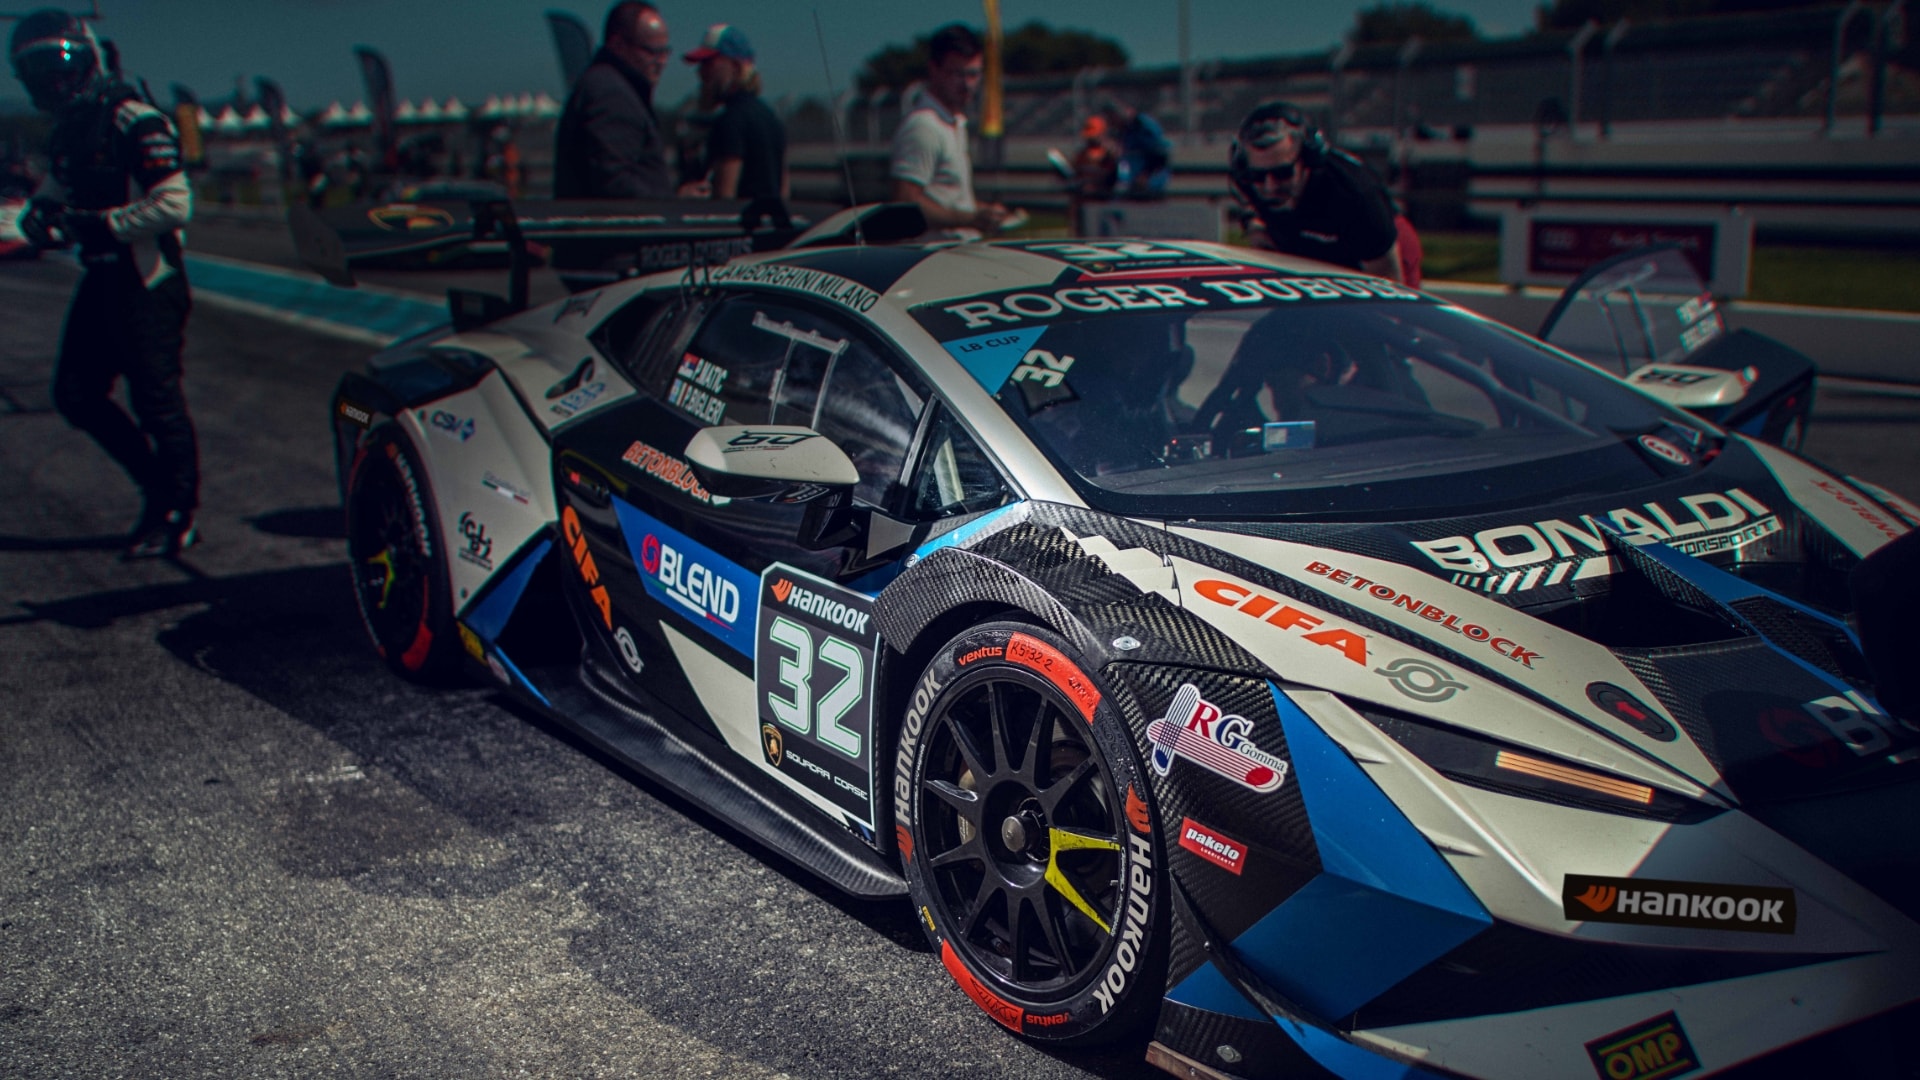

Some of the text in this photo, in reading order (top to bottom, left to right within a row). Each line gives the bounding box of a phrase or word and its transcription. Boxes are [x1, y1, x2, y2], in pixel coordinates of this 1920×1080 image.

[712, 264, 879, 313] LAMBORGHINI MILANO
[944, 277, 1420, 330] ROGER DUBUIS
[960, 335, 1020, 353] LB CUP
[1011, 349, 1076, 388] 32
[1409, 487, 1772, 573] BONALDI
[561, 504, 613, 632] CIFA
[659, 544, 740, 623] BLEND
[1193, 579, 1367, 667] CIFA
[1304, 561, 1544, 669] BETONBLOCK
[768, 615, 864, 758] 32
[1186, 700, 1285, 773] RG Gomma
[785, 750, 868, 800] SQUADRA CORSE
[1186, 827, 1240, 861] pakelo
[1605, 1031, 1682, 1080] OMP
